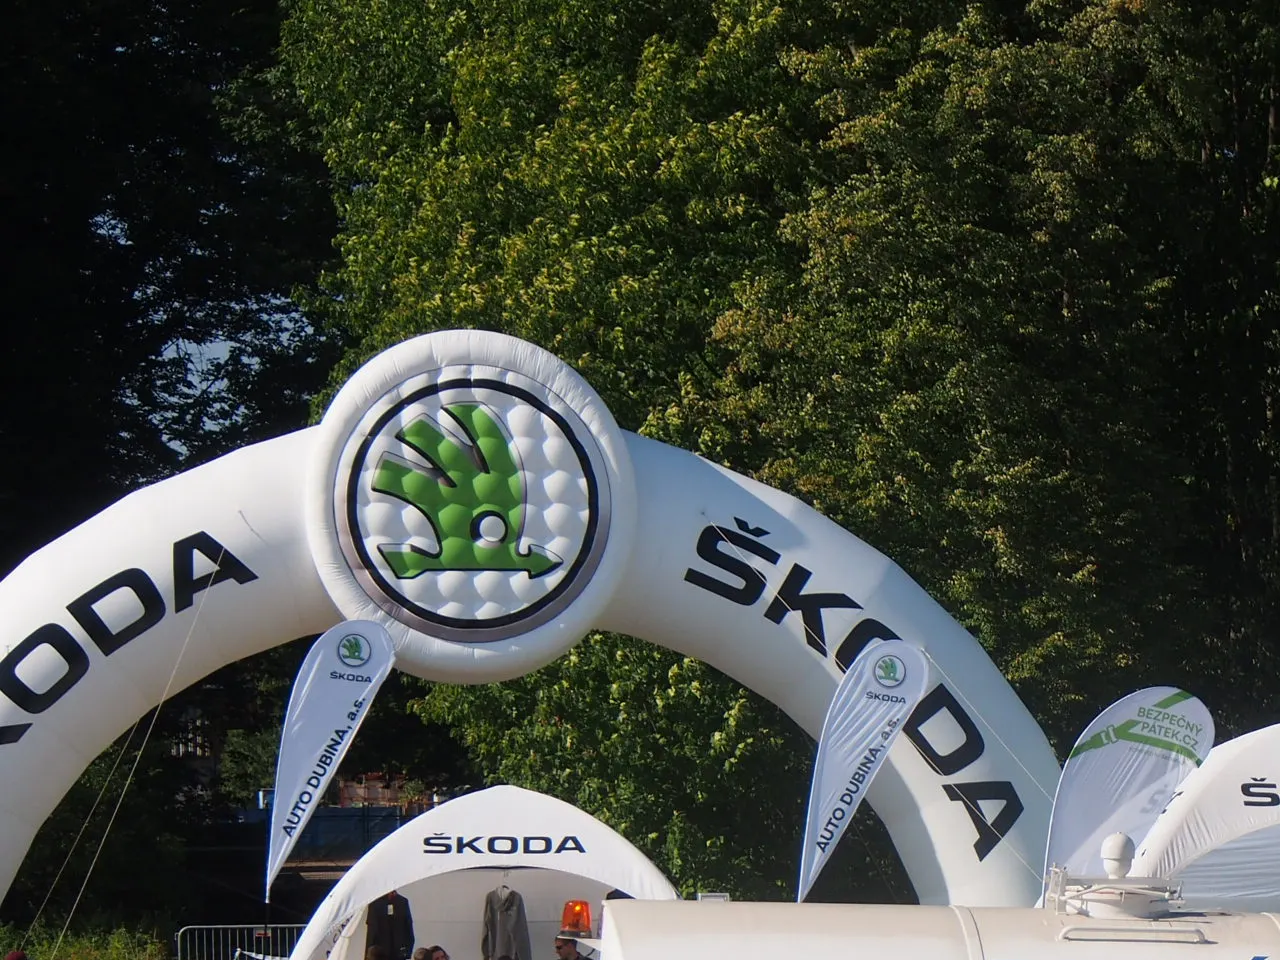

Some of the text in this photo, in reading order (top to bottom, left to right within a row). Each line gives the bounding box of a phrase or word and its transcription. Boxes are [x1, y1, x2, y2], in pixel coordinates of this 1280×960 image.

[0, 530, 259, 745] ODA
[330, 671, 372, 683] ŠKODA
[866, 691, 906, 704] ŠKODA
[1137, 706, 1203, 737] BEZPEČNÝ
[1140, 720, 1199, 751] PÁTEK.CZ
[282, 697, 366, 838] AUTO DUBINA, a.s.
[816, 717, 900, 853] AUTO DUBINA, a.s.
[423, 832, 587, 855] ŠKODA
